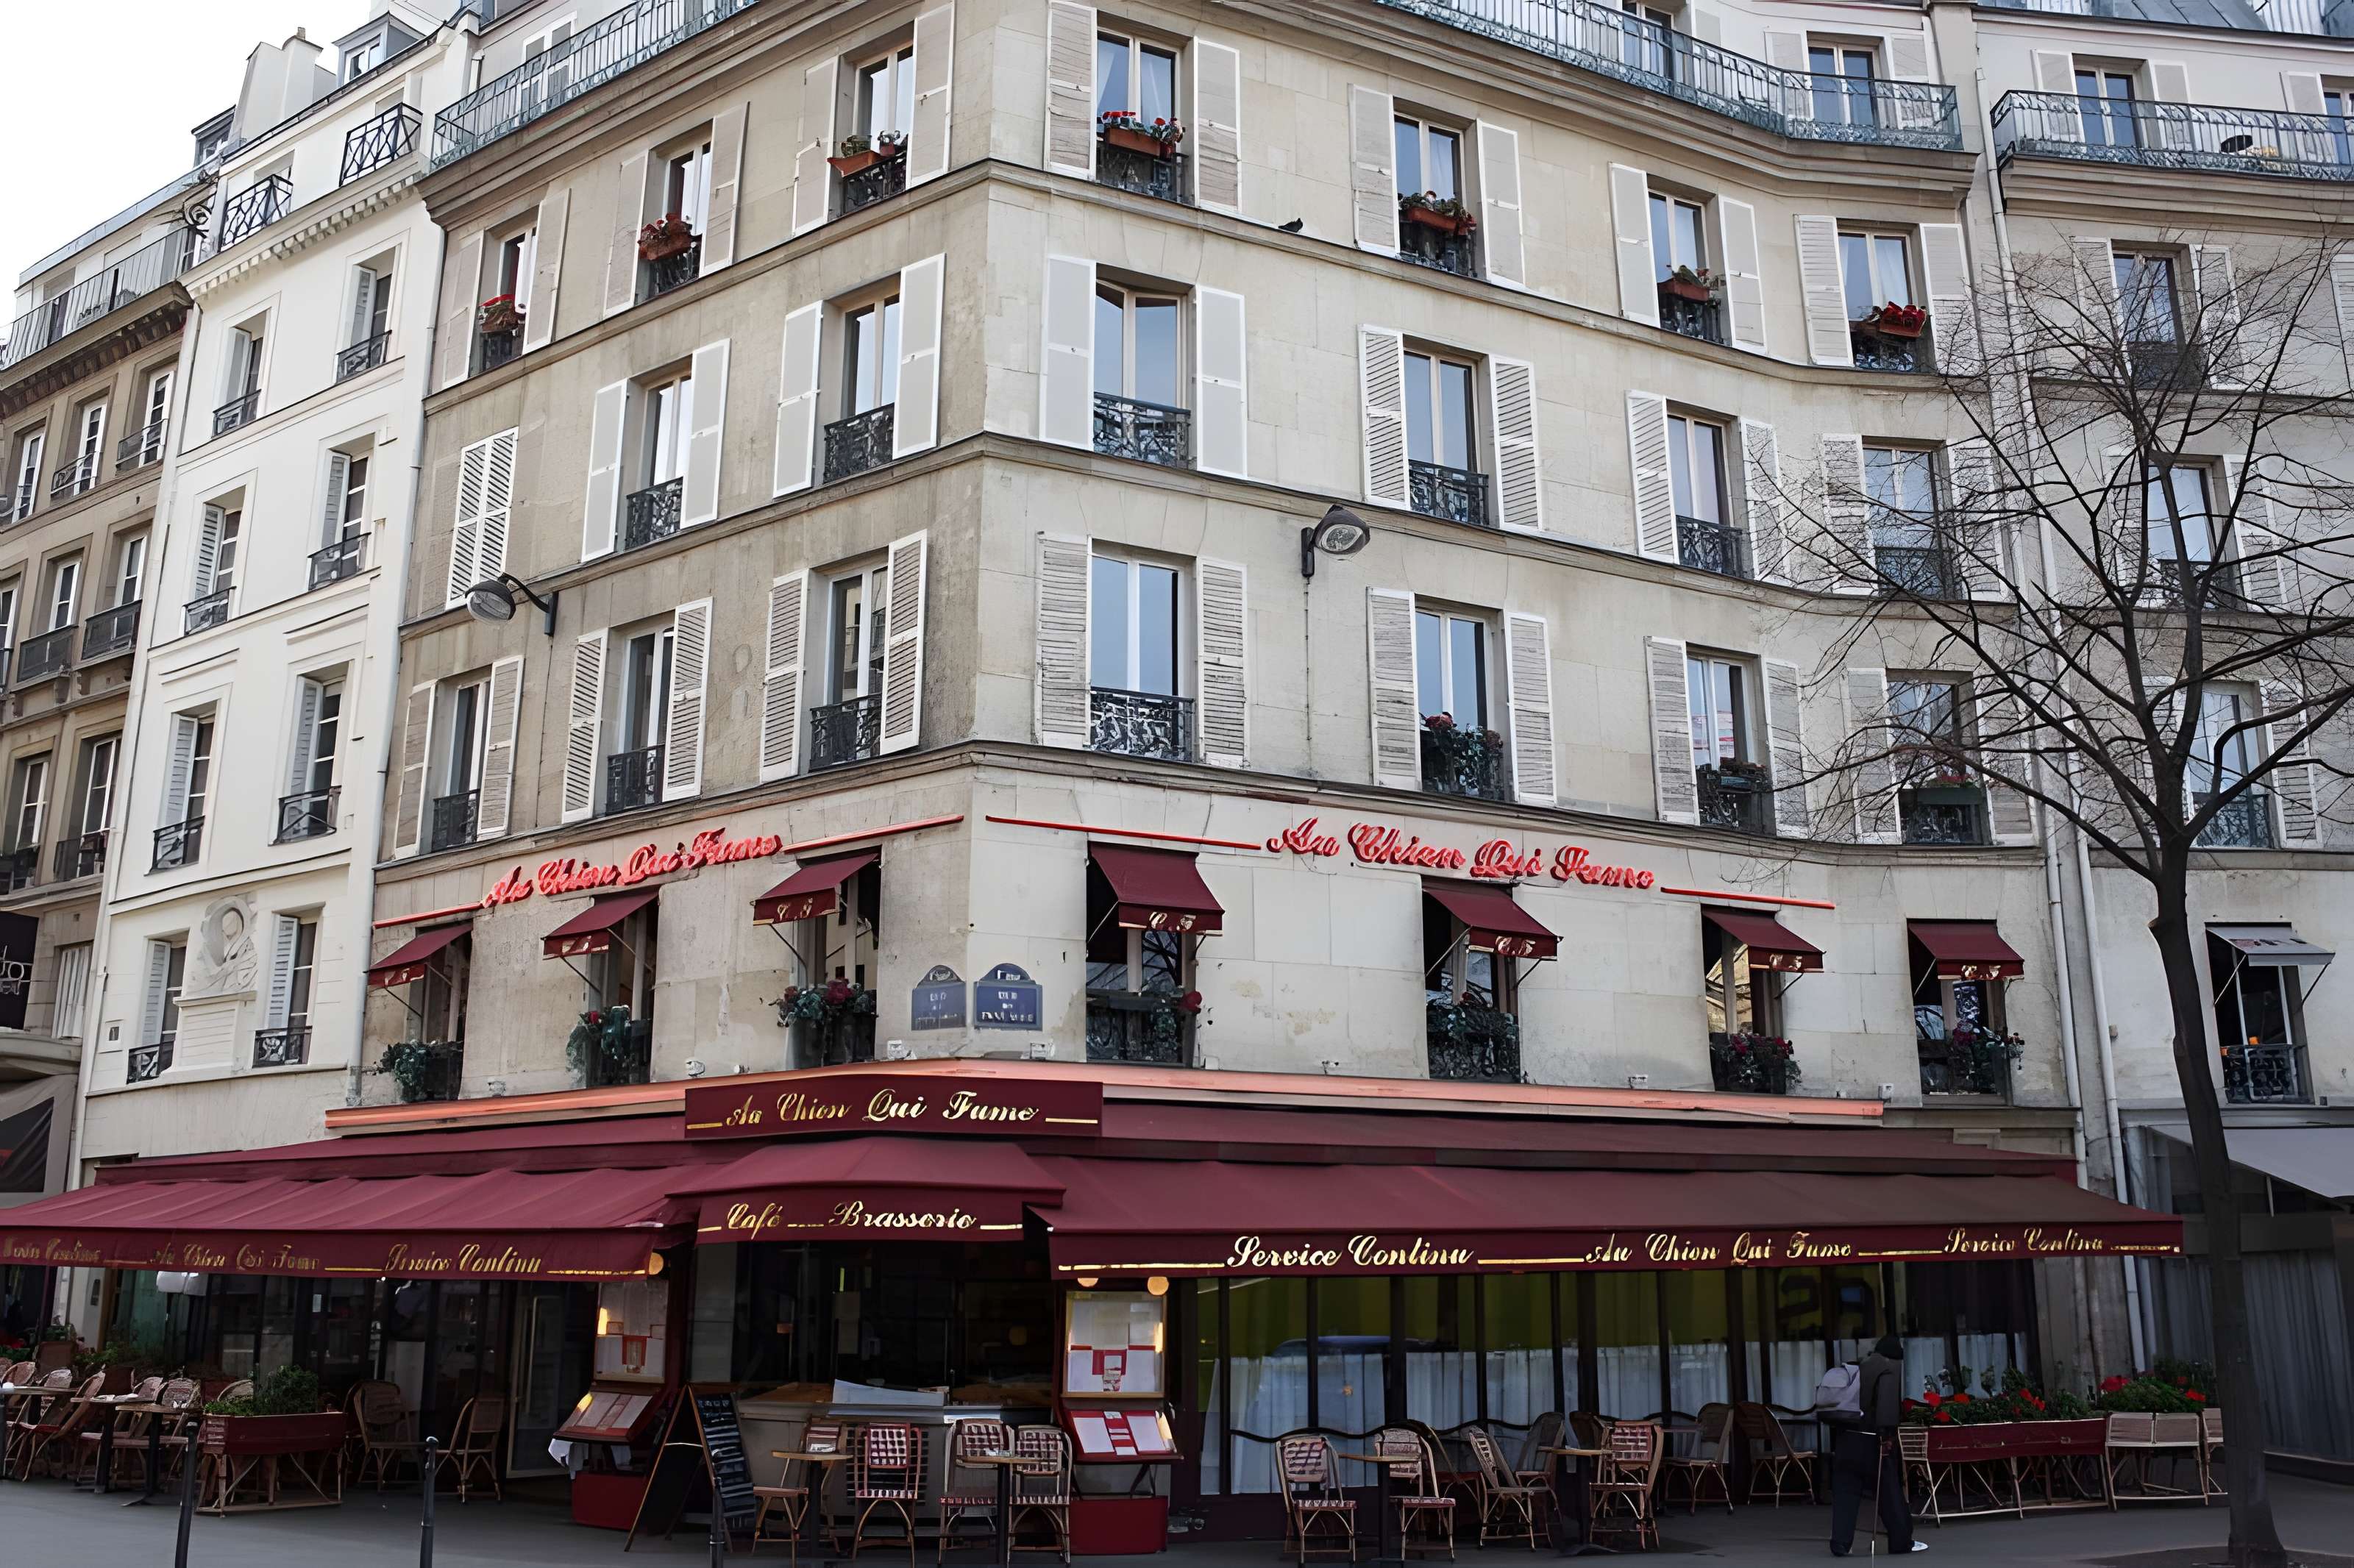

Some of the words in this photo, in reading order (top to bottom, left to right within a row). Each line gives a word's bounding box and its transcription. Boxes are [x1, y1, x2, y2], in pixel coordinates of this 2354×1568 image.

[861, 1088, 928, 1123] Qui
[726, 1202, 782, 1240] Café
[1226, 1235, 1343, 1268] Service
[1347, 1234, 1475, 1266] Continu
